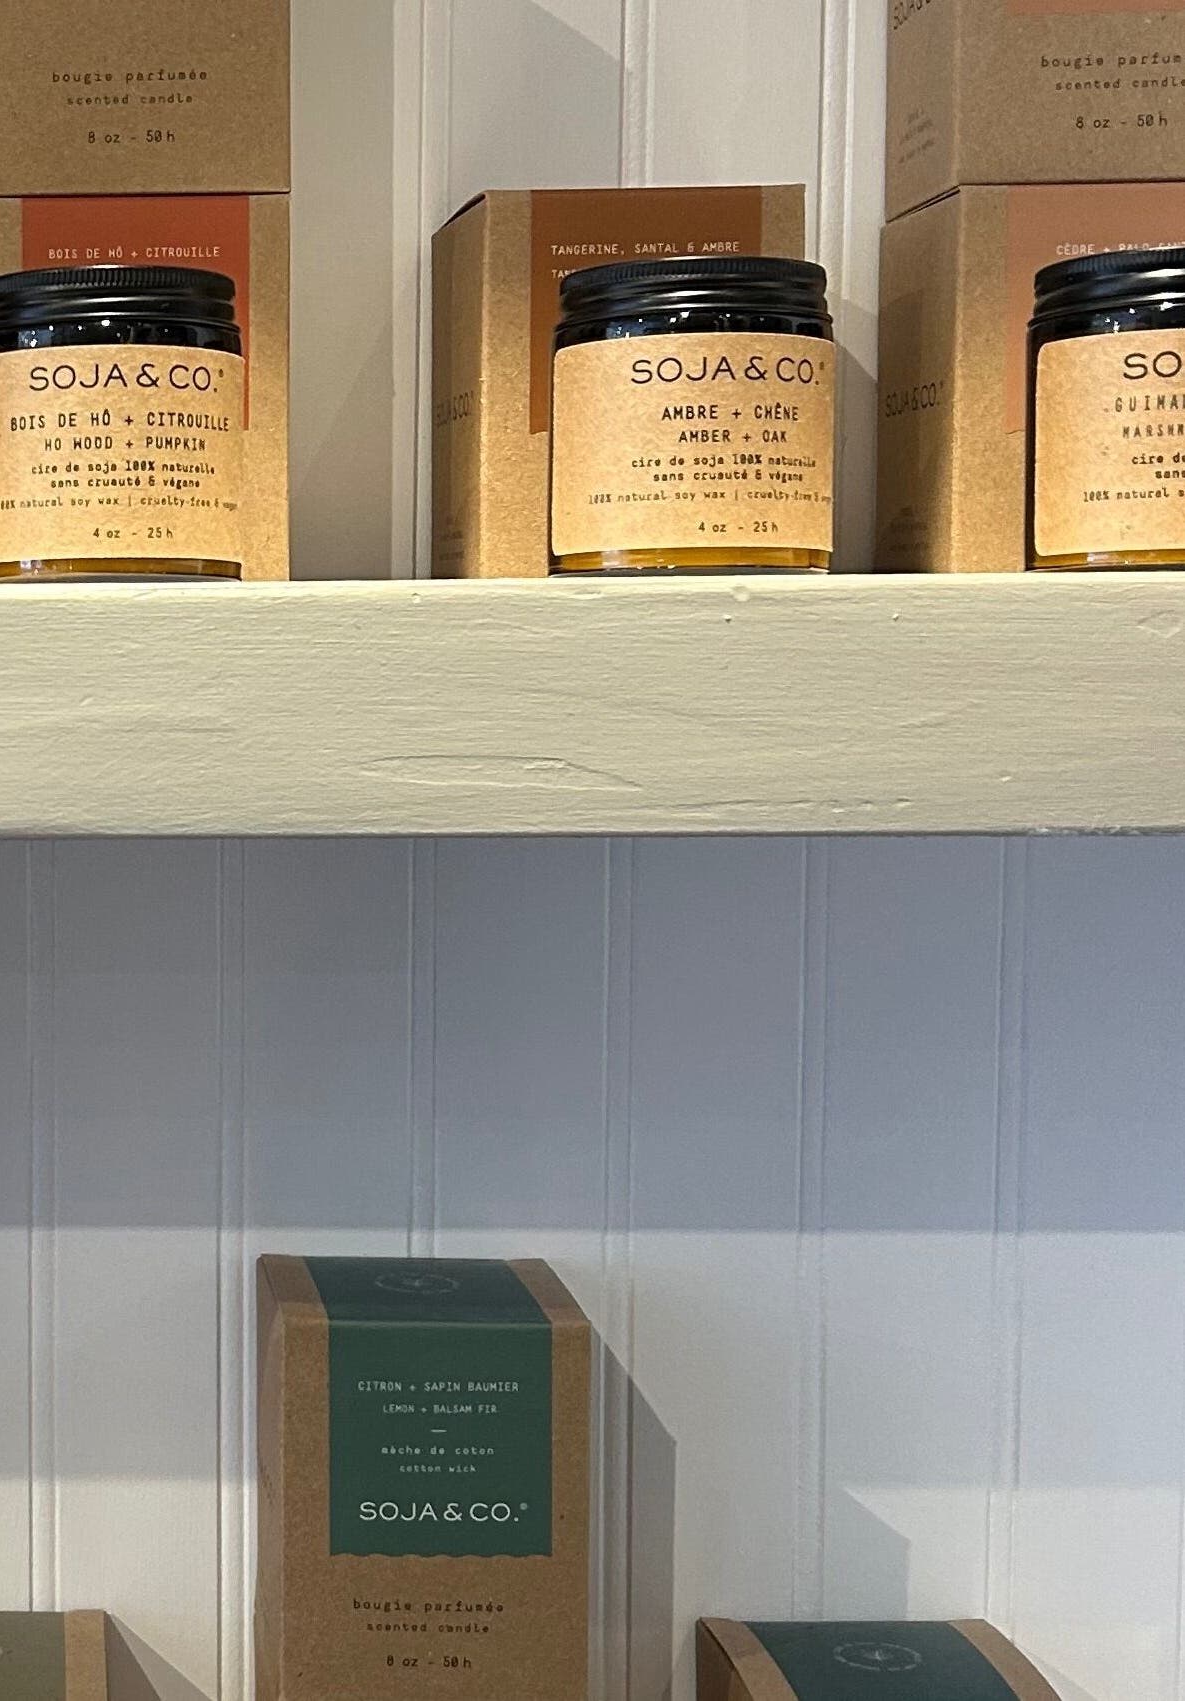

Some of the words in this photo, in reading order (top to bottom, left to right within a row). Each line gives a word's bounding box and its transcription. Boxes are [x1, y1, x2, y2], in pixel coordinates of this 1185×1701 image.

[1041, 56, 1104, 70] bougie
[52, 72, 112, 84] bougie
[125, 69, 208, 84] parfumée
[1055, 78, 1121, 90] scented
[67, 96, 129, 105] scented
[139, 94, 193, 105] candle
[1075, 116, 1084, 128] 8
[1093, 118, 1110, 129] oz
[88, 132, 96, 144] 8
[105, 134, 120, 143] oz
[48, 248, 78, 259] BOIS
[86, 248, 101, 259] DE
[109, 245, 124, 259] HÔ
[146, 246, 220, 258] CITROUILLE
[551, 244, 625, 255] TANGERINE,
[634, 242, 678, 253] SANTAL
[687, 243, 694, 252] &
[702, 241, 740, 253] AMBRE
[661, 404, 719, 421] AMBRE
[754, 402, 799, 421] CHÊNE
[10, 415, 45, 431] BOIS
[59, 413, 77, 427] DE
[91, 409, 111, 426] HÔ
[147, 411, 229, 432] CITROUILLE
[679, 430, 731, 443] AMBER
[763, 430, 787, 442] OAK
[45, 438, 62, 451] HO
[73, 437, 113, 450] WOOD
[146, 436, 206, 451] PUMPKIN
[632, 458, 661, 468] cire
[669, 457, 685, 466] de
[693, 456, 724, 467] soja
[733, 453, 762, 464] 100%
[1132, 453, 1164, 464] cire
[32, 464, 58, 475] cire
[65, 462, 79, 473] de
[88, 462, 117, 474] soja
[125, 460, 155, 471] 100%
[51, 479, 79, 488] sans
[88, 476, 141, 488] cruauté
[653, 472, 684, 482] sans
[693, 470, 748, 480] cruauté
[618, 491, 666, 502] natural
[675, 492, 696, 501] soy
[704, 491, 726, 499] wax
[1116, 488, 1169, 499] natural
[20, 497, 63, 508] natural
[71, 498, 90, 507] soy
[93, 528, 100, 539] 4
[106, 529, 120, 539] oz
[699, 522, 705, 532] 4
[712, 524, 727, 533] oz
[358, 1382, 401, 1392] CITRON
[424, 1382, 461, 1392] SAPIN
[467, 1382, 519, 1392] BAUMIER
[383, 1404, 414, 1413] LEMON
[433, 1404, 472, 1414] BALSAM
[479, 1404, 497, 1414] FIR
[430, 1446, 445, 1455] de
[455, 1447, 494, 1455] coton
[399, 1464, 441, 1472] cotton
[449, 1464, 476, 1472] wick
[353, 1600, 411, 1613] bougie
[425, 1601, 503, 1614] parfumée
[367, 1622, 427, 1632] scented
[438, 1624, 489, 1634] candle
[403, 1657, 419, 1666] oz
